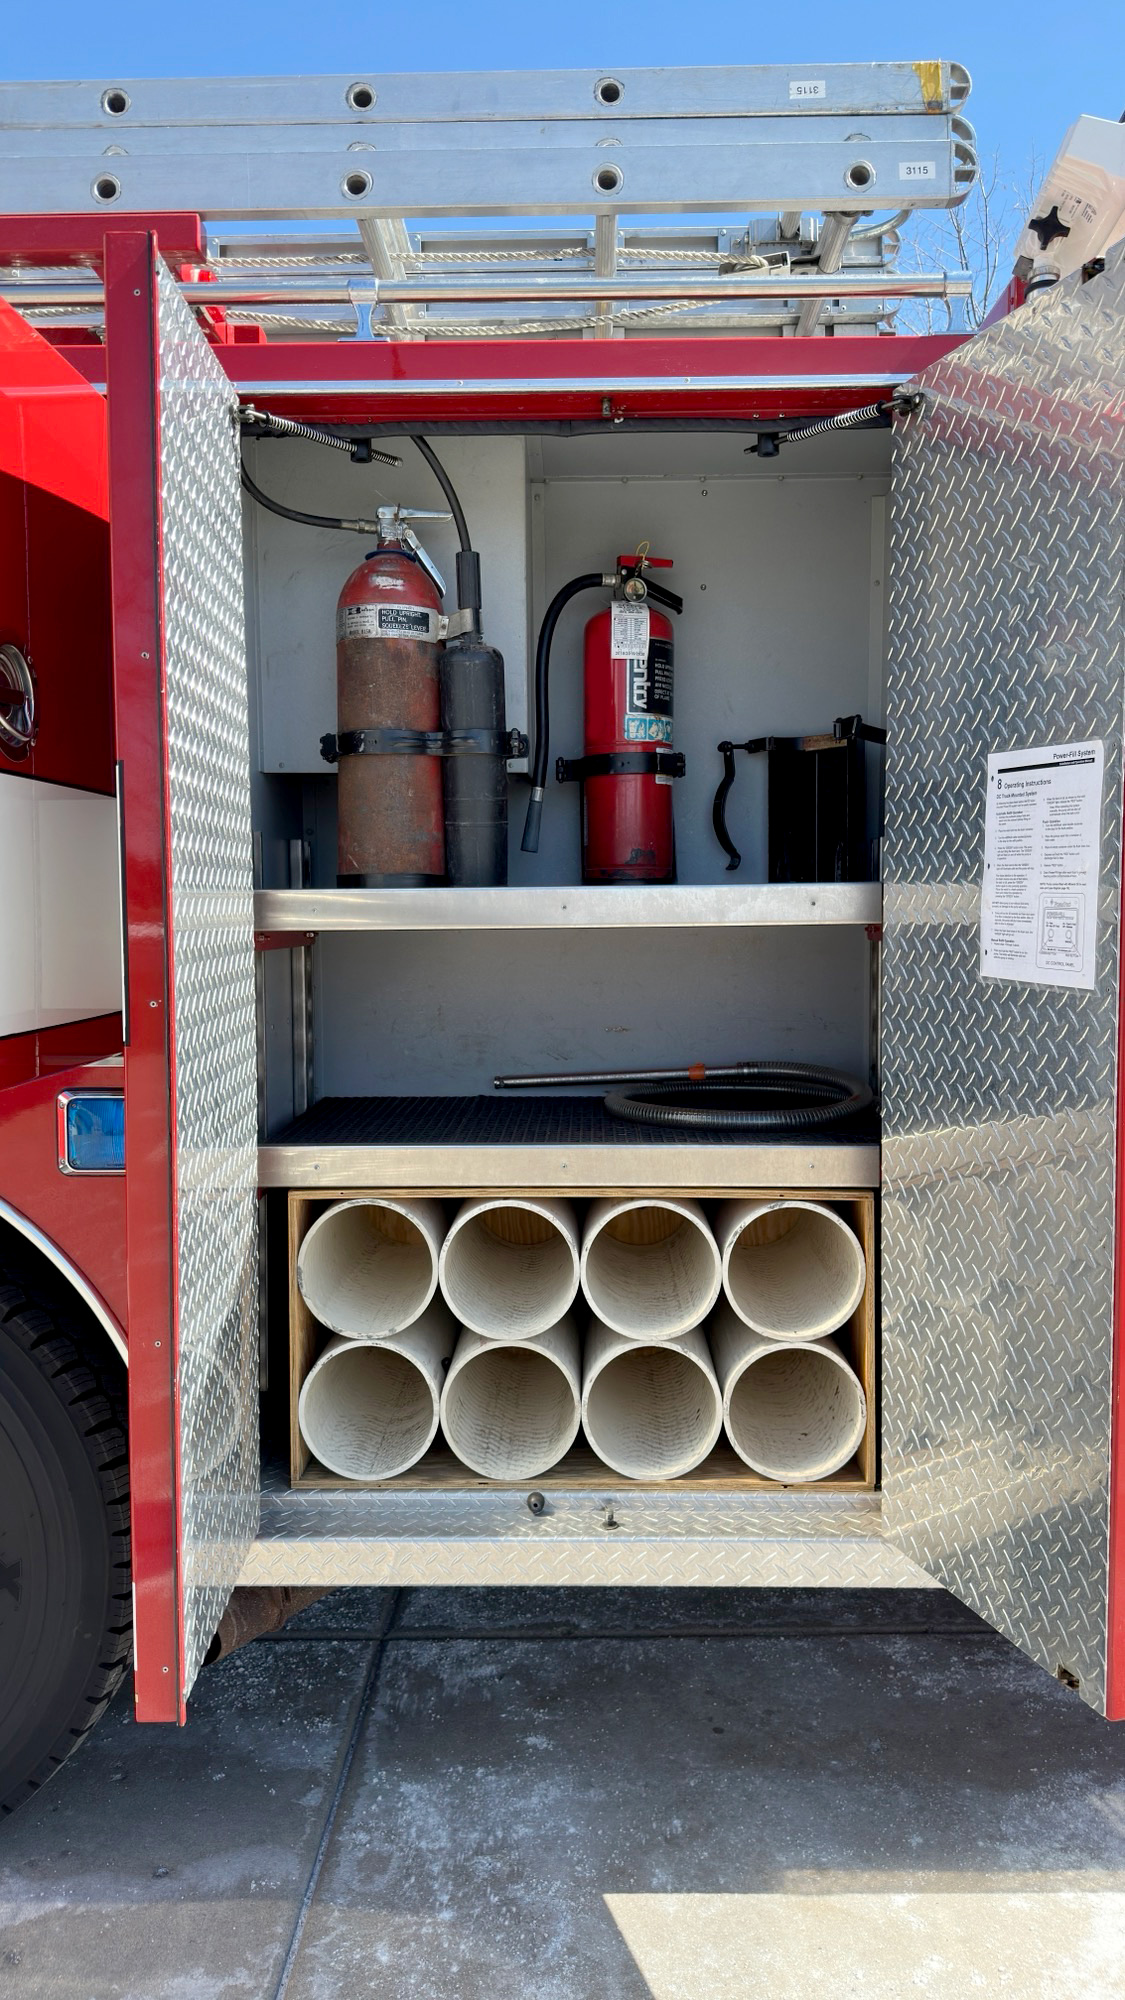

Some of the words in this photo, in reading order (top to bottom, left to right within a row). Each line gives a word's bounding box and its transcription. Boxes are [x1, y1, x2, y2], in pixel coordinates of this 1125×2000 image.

[796, 85, 819, 95] 3115
[905, 165, 929, 176] 3115
[633, 659, 651, 709] entry
[1052, 751, 1077, 760] Power-Fill
[1077, 749, 1096, 758] System
[997, 778, 1002, 790] 8
[1003, 781, 1025, 790] Operating
[1025, 779, 1052, 787] Instructions
